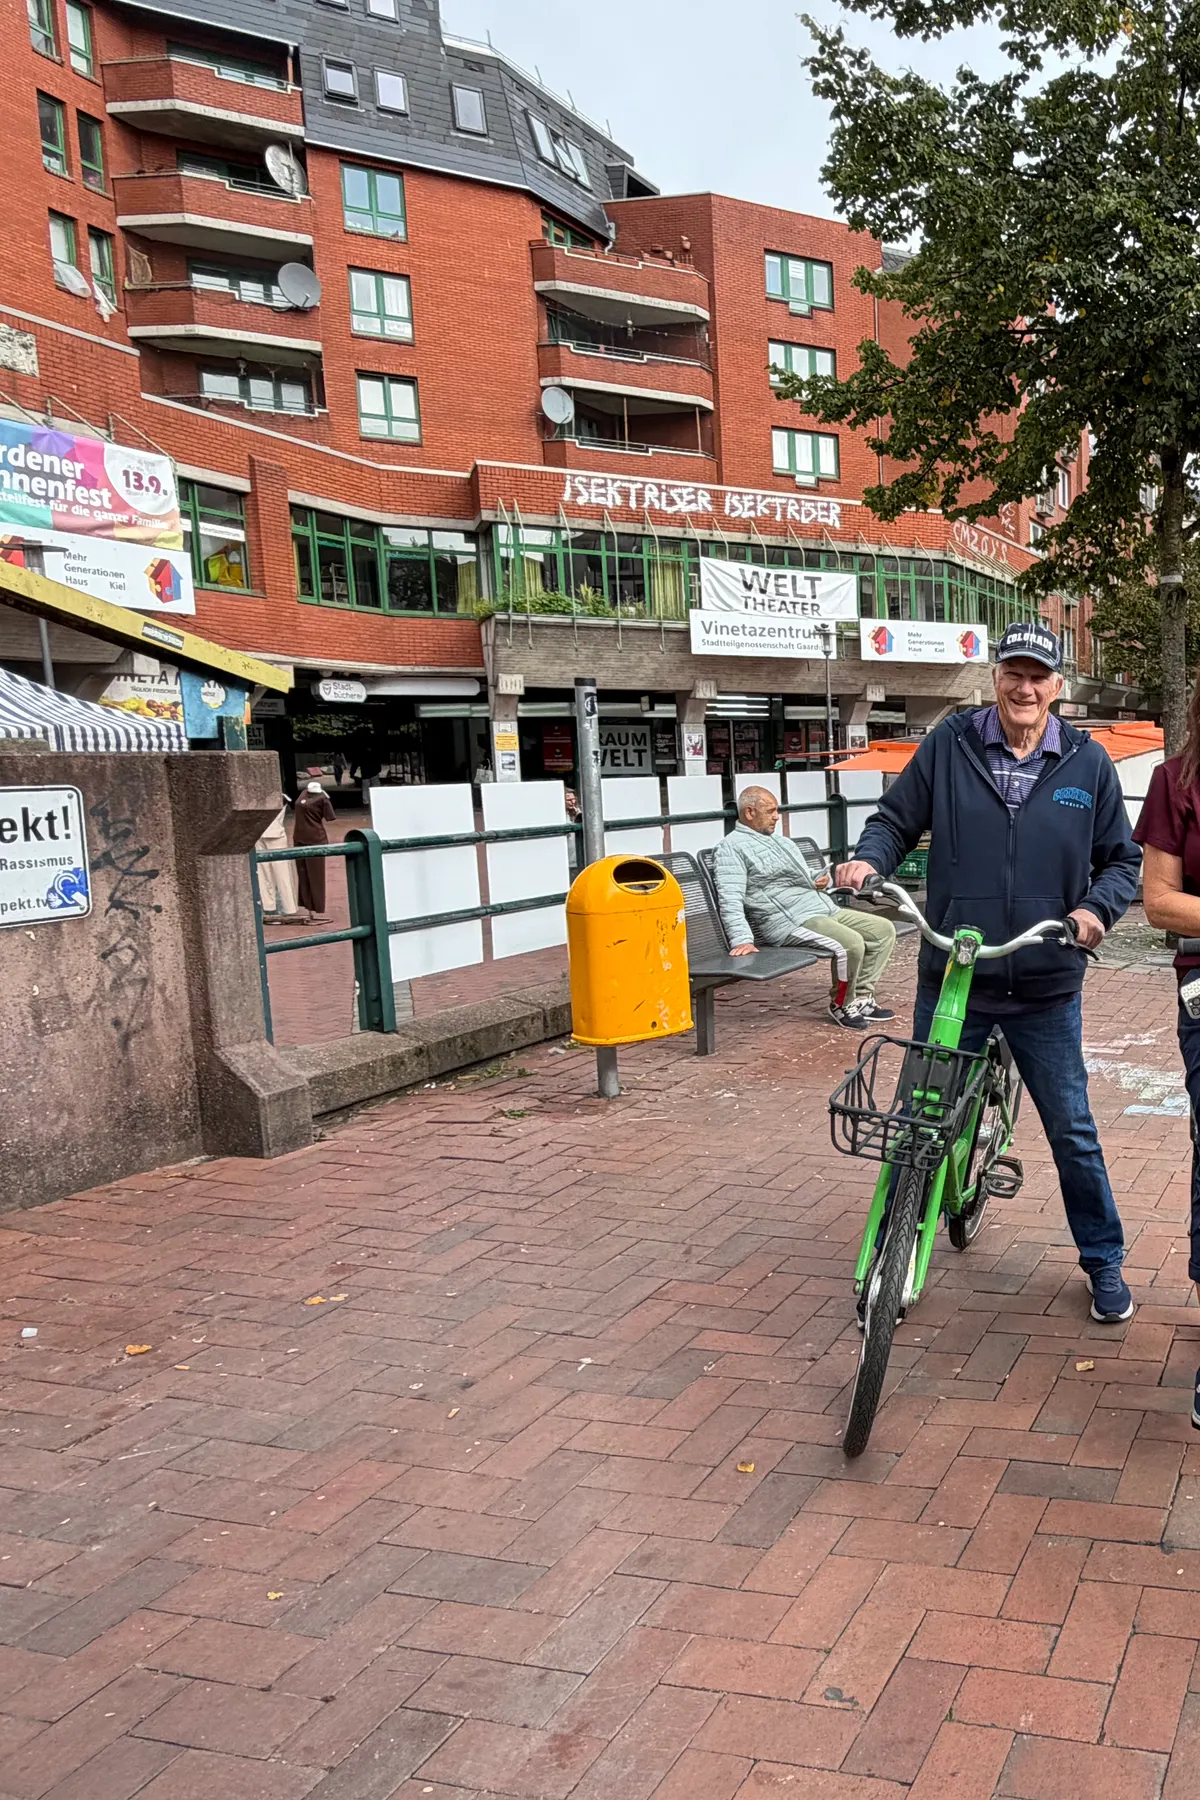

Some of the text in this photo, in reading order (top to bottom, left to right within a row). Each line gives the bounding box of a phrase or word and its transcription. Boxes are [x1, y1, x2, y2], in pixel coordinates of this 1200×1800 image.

[122, 469, 168, 496] 13.9.
[49, 499, 68, 512] für
[71, 504, 91, 516] die
[93, 510, 129, 522] ganze
[63, 551, 87, 562] Mehr
[64, 563, 125, 579] Generationen
[65, 576, 126, 591] Haus Kiel
[739, 568, 822, 600] WELT
[741, 595, 822, 617] THEATER
[701, 639, 795, 650] Stadtteilgenossenschaft
[1006, 632, 1053, 652] COLORADO
[0, 805, 71, 844] ekt!
[0, 856, 74, 871] Rassismus
